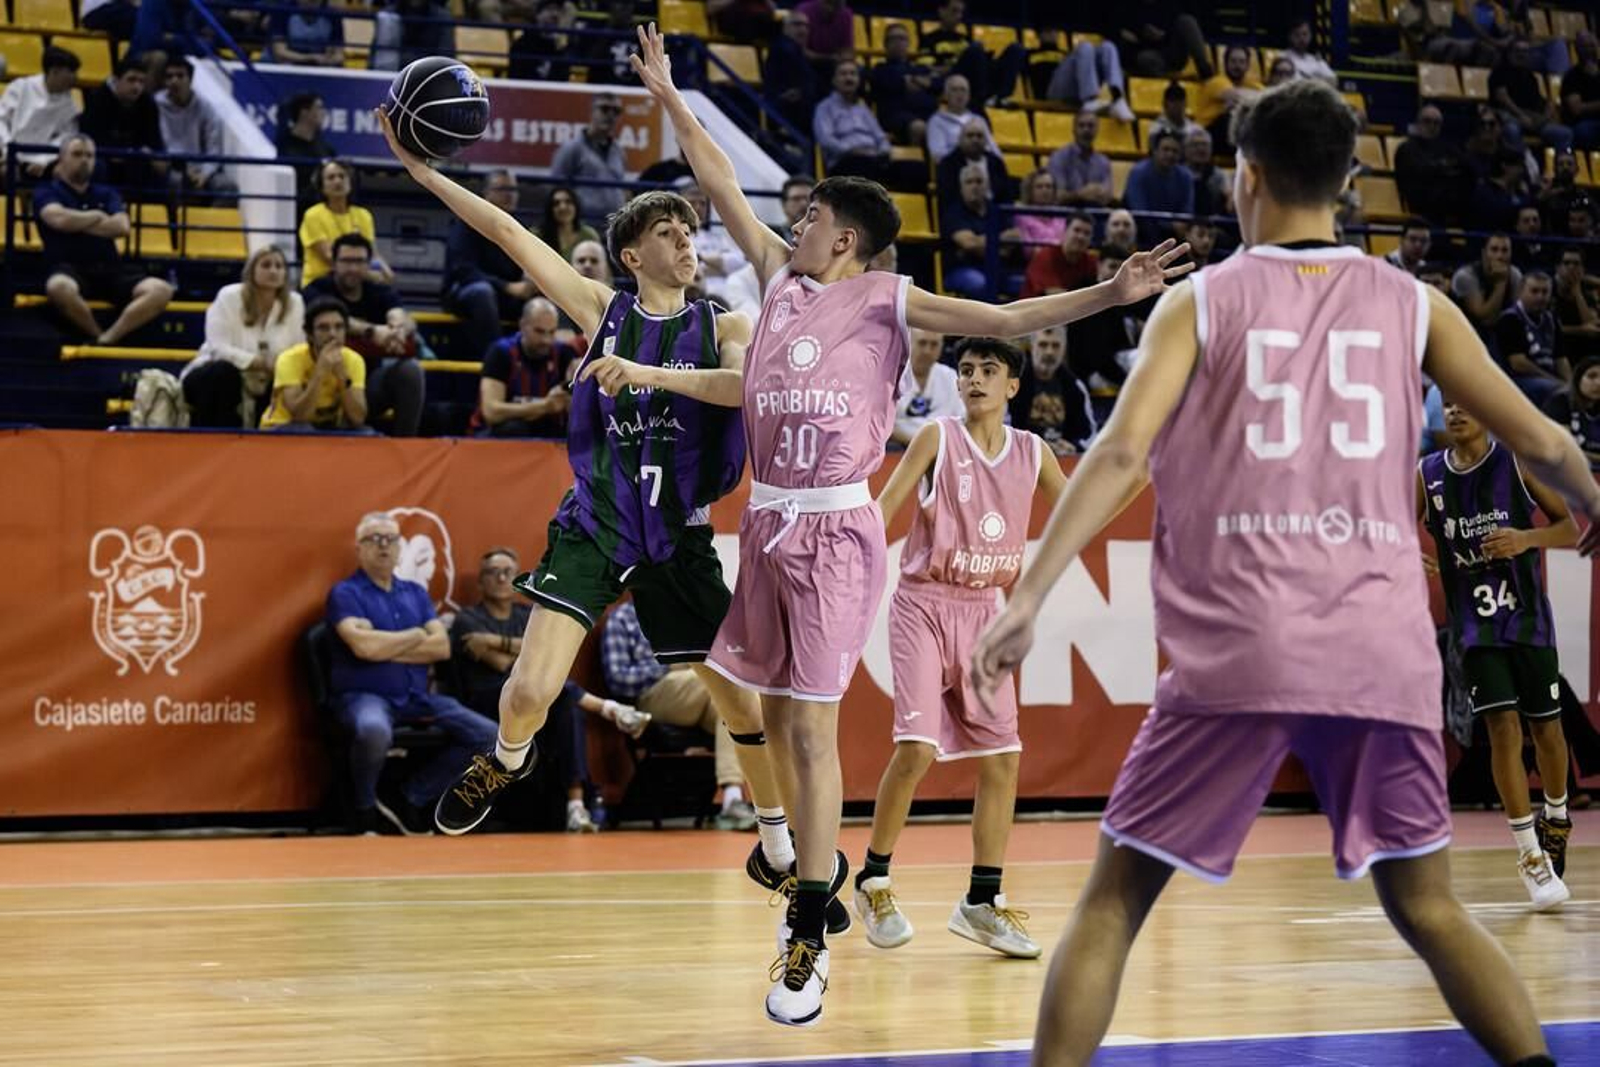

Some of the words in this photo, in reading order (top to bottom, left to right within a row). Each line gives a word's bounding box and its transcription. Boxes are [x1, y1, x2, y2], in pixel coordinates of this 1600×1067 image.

[756, 388, 850, 418] PROBITAS
[1246, 329, 1385, 459] 55
[774, 423, 819, 470] 30
[1217, 512, 1313, 536] BADALONA
[951, 550, 1022, 575] PROBITAS
[1473, 580, 1518, 617] 34
[34, 695, 146, 732] Cajasiete
[153, 695, 257, 725] Canarias
